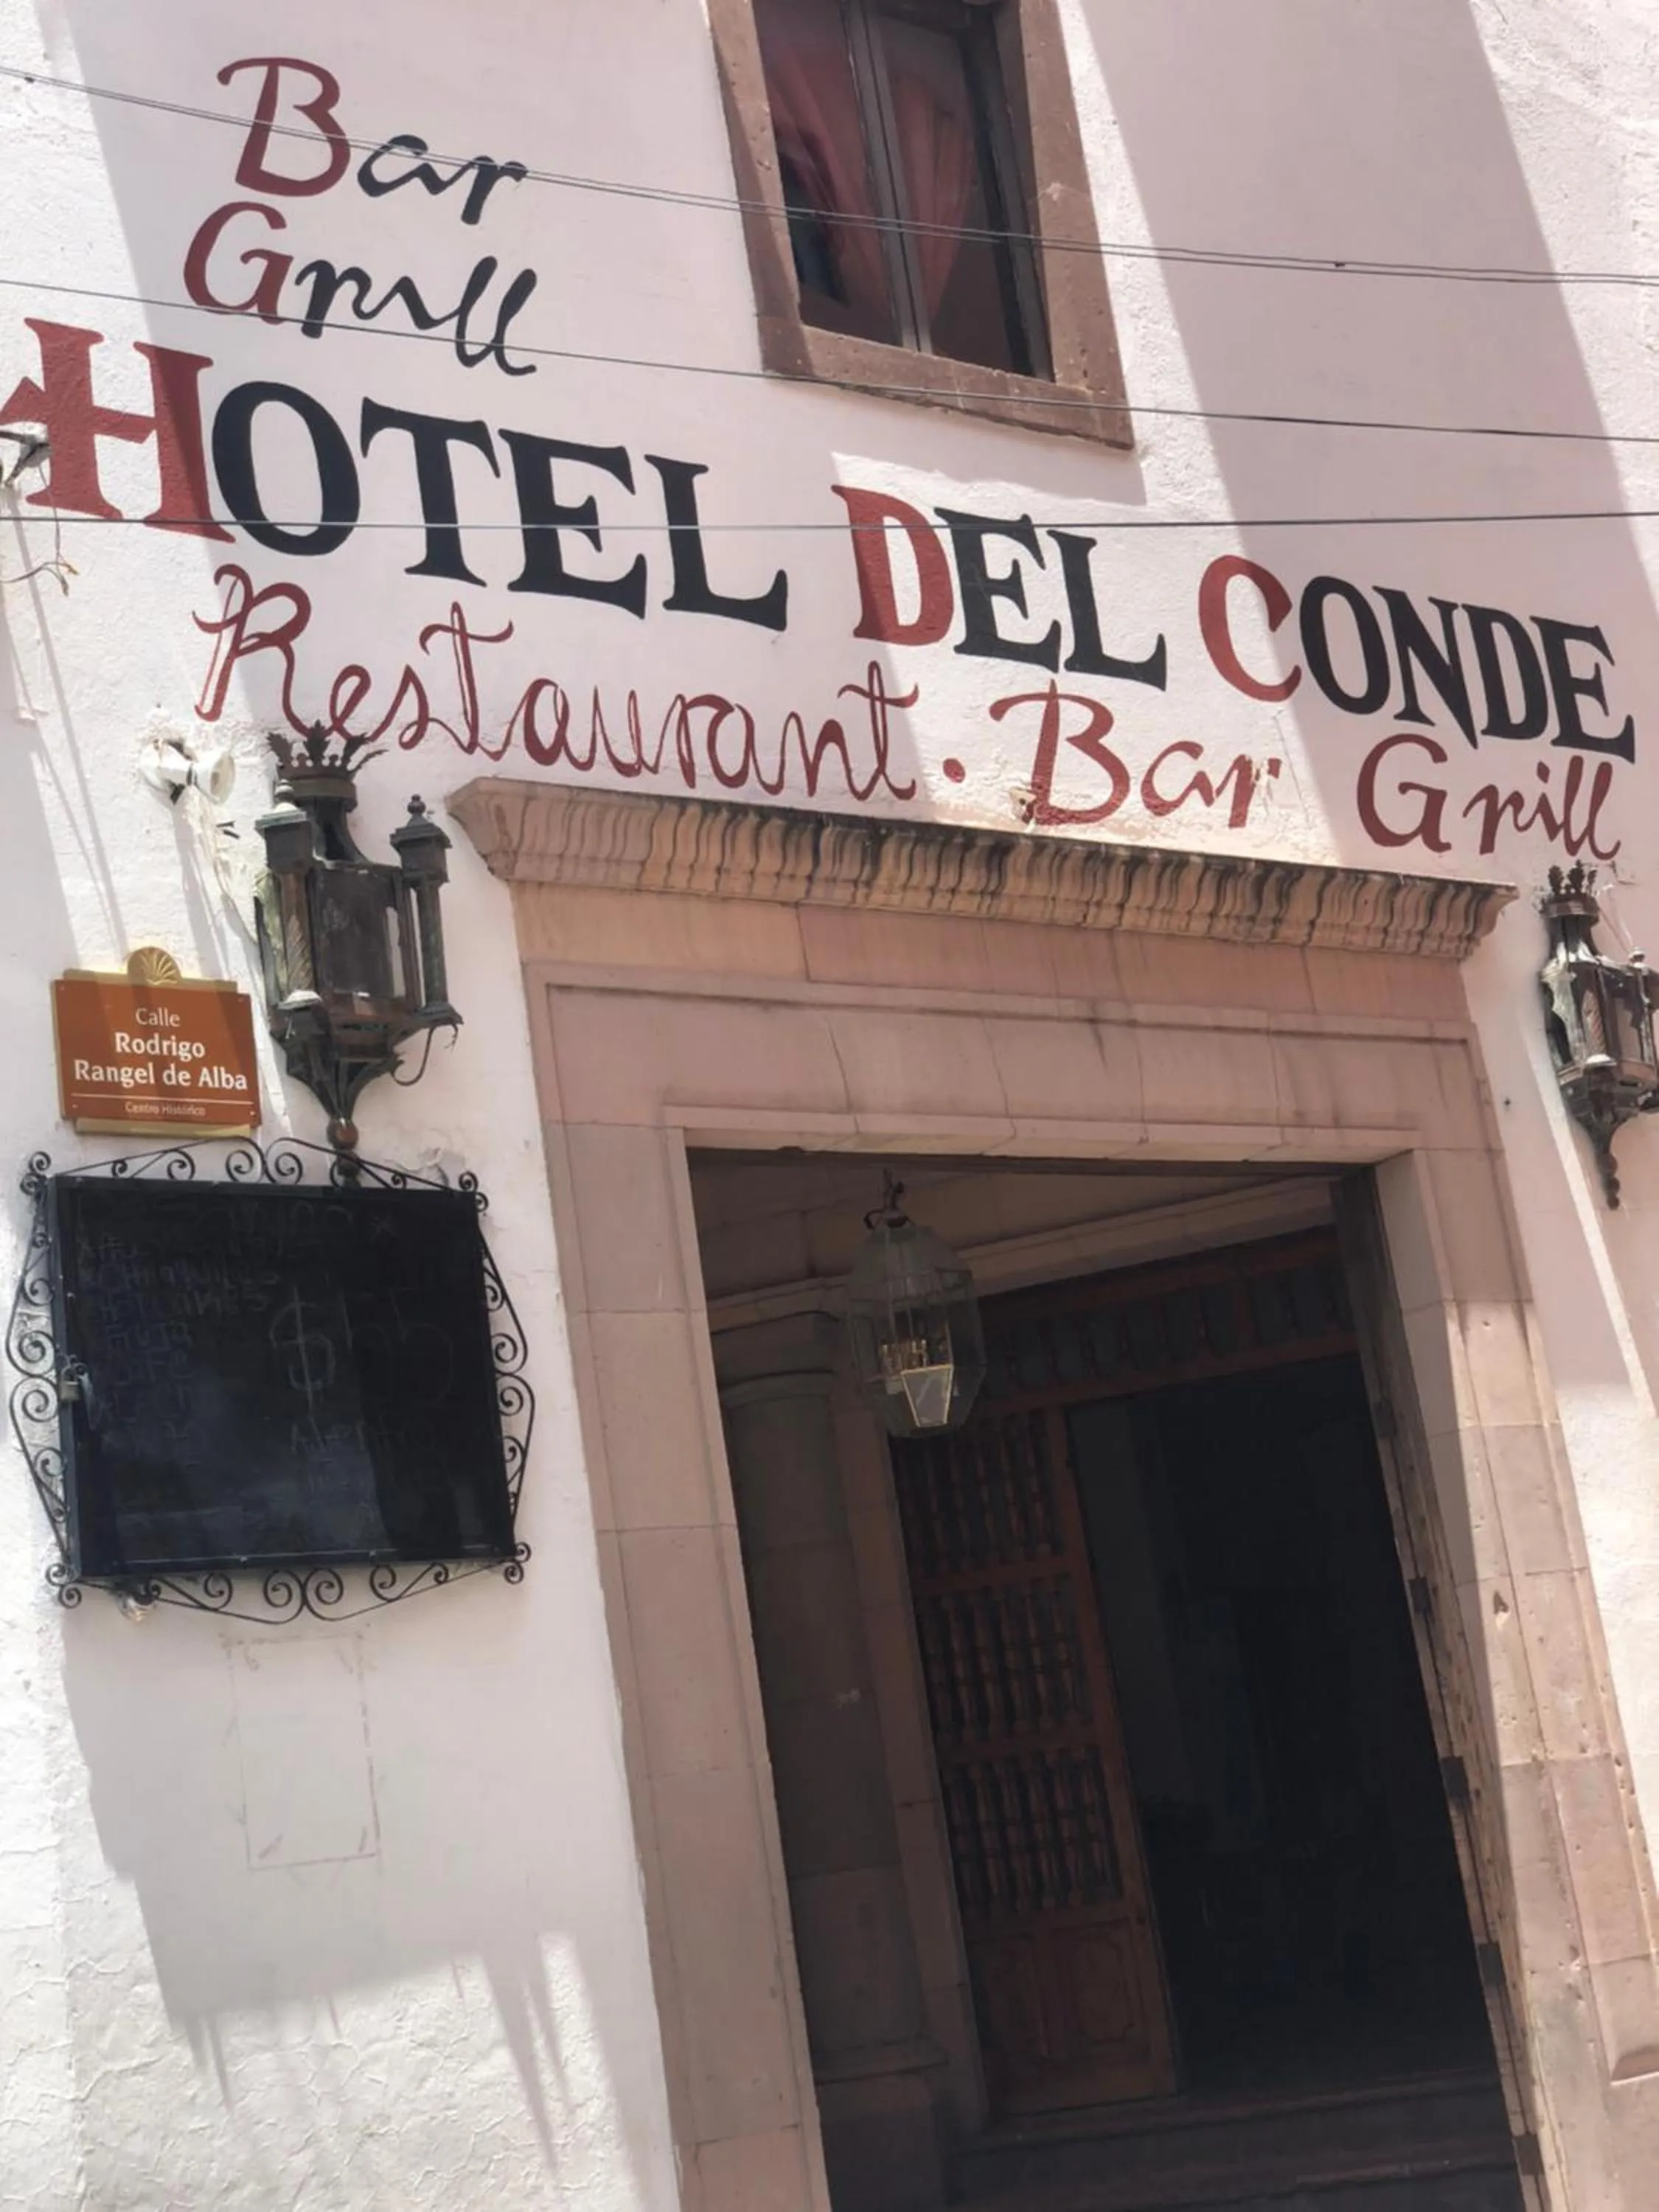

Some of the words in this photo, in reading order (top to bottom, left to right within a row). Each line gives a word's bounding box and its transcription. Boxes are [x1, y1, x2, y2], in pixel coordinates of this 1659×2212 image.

[216, 57, 528, 225] Bar
[183, 201, 537, 376] Grill
[0, 317, 788, 632] HOTEL
[831, 484, 1167, 692] DEL
[1197, 554, 1636, 764] CONDE
[192, 564, 919, 801] Restaurant
[990, 679, 1281, 829] Bar
[1356, 733, 1621, 860] Grill
[114, 1032, 206, 1062] Rodrigo
[135, 1007, 181, 1027] Calle
[74, 1059, 156, 1089] Rangel
[162, 1063, 192, 1086] de
[198, 1066, 248, 1091] Alba
[125, 1102, 160, 1115] Centro
